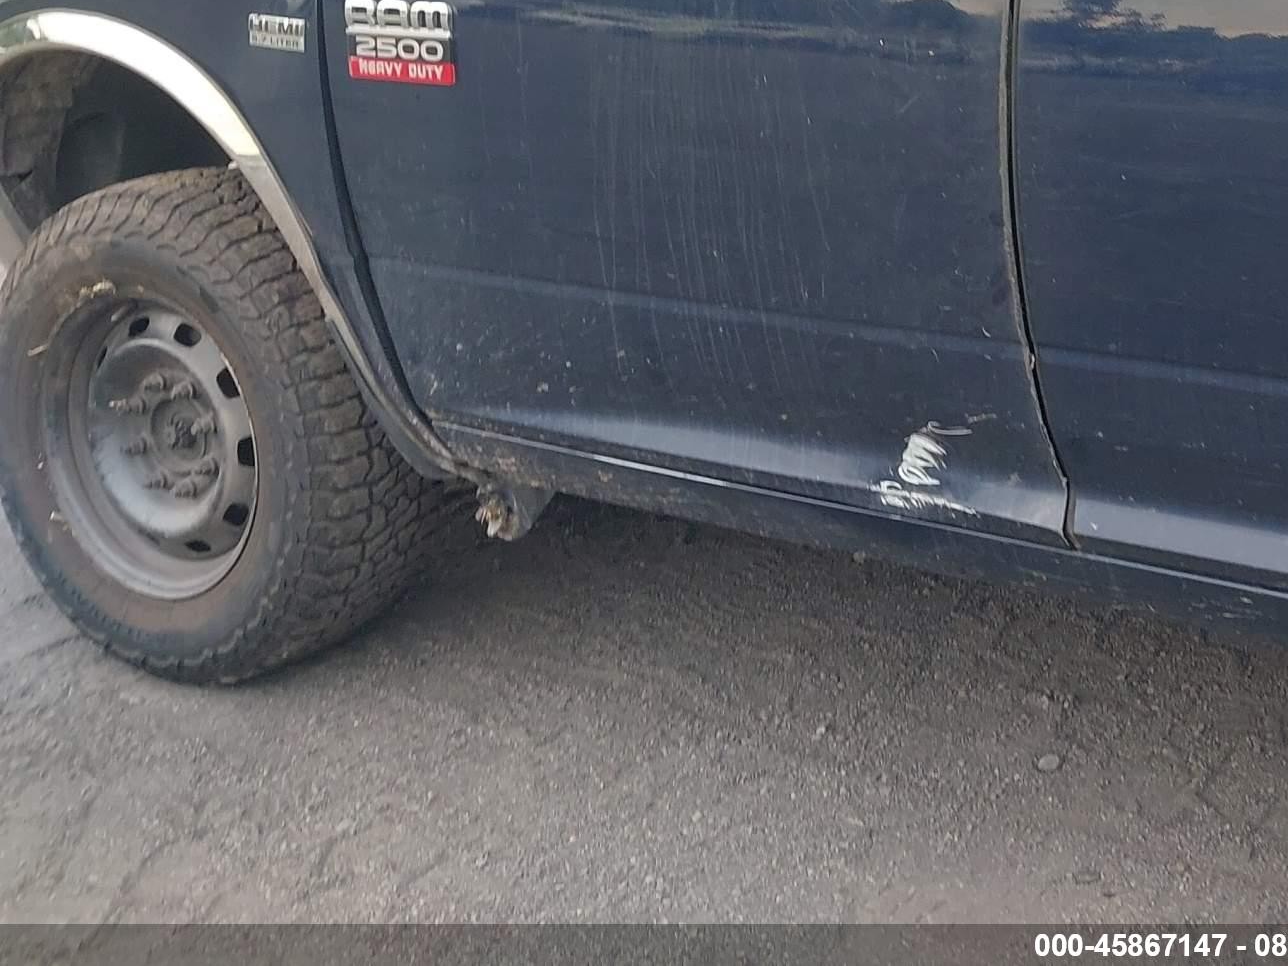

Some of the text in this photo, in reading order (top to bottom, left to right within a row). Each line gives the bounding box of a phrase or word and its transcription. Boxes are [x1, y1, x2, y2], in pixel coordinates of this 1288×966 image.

[249, 13, 305, 35] HEMI
[356, 34, 444, 62] 2500
[359, 58, 444, 81] HEAVY DUTY
